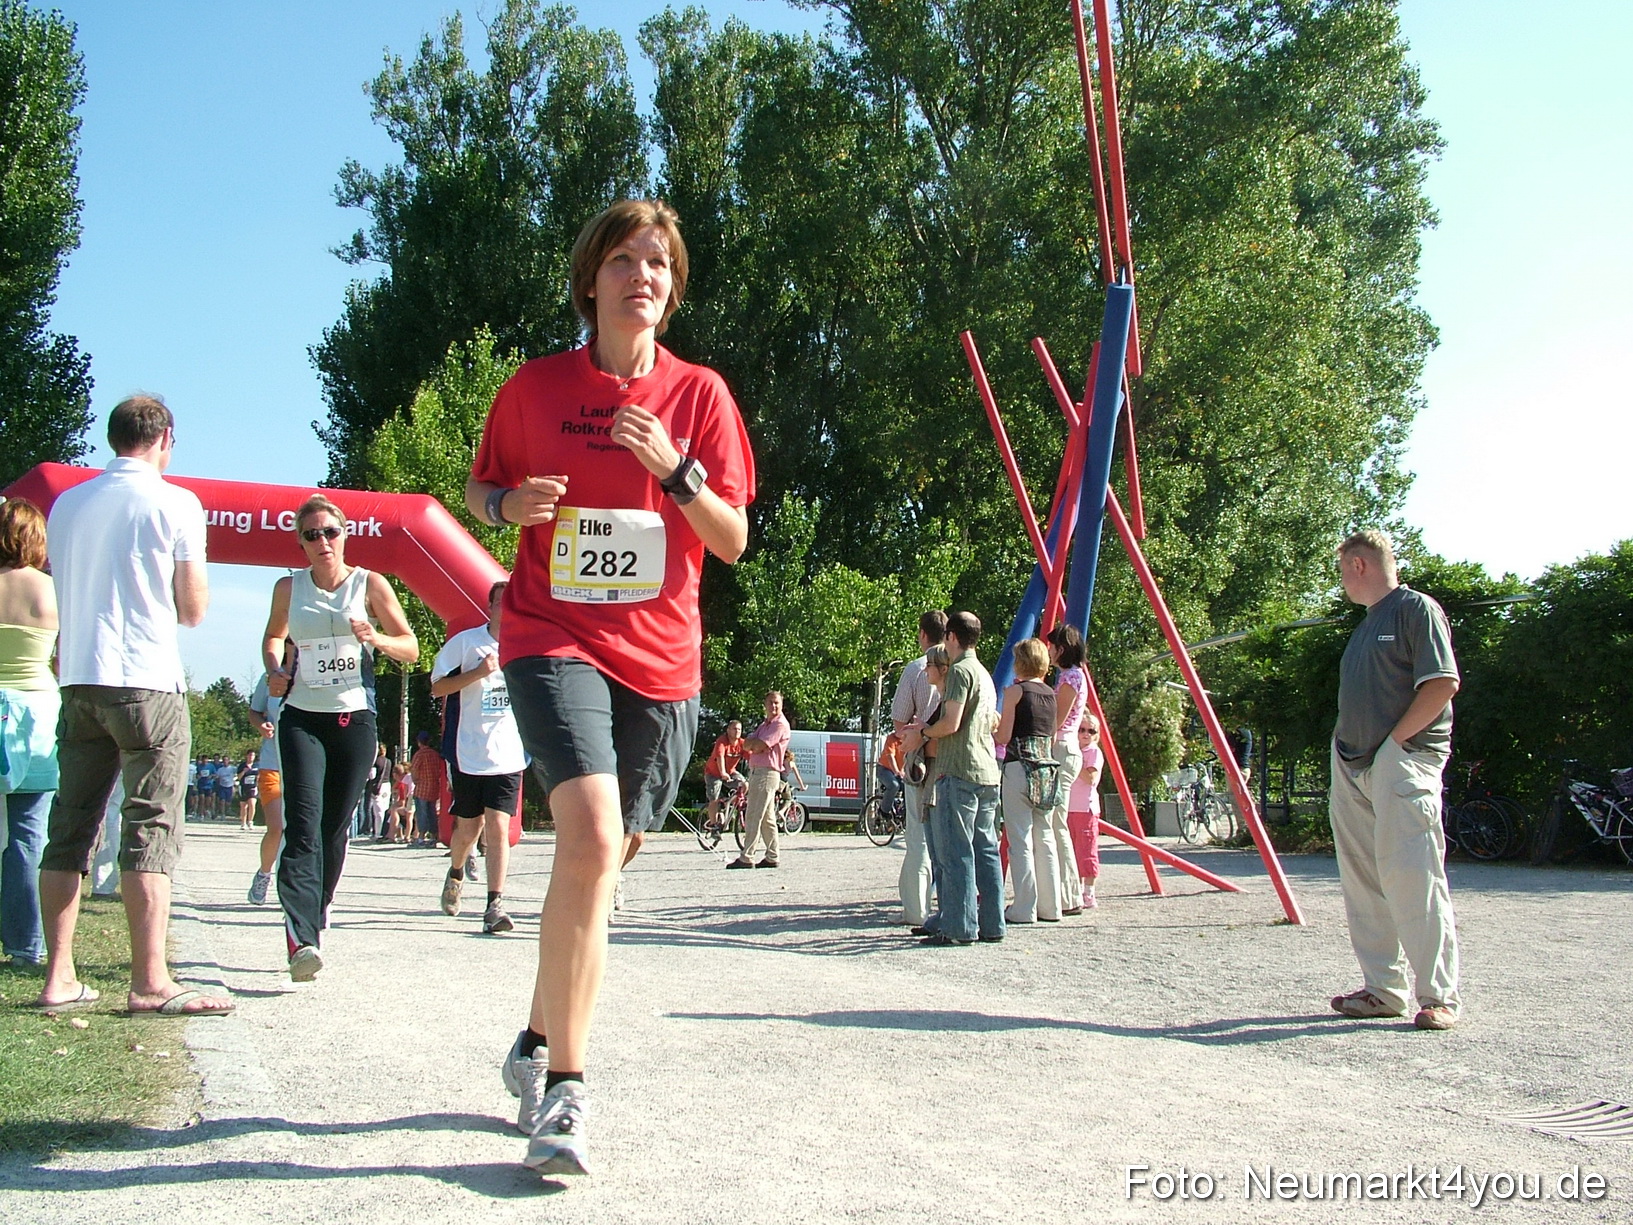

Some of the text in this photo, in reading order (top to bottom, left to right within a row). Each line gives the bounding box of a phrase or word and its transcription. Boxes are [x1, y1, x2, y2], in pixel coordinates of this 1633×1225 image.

[579, 519, 612, 537] Elke
[557, 541, 569, 557] D
[579, 549, 638, 578] 282
[318, 643, 331, 651] Evi
[317, 656, 356, 674] 3498
[826, 775, 856, 789] Braun
